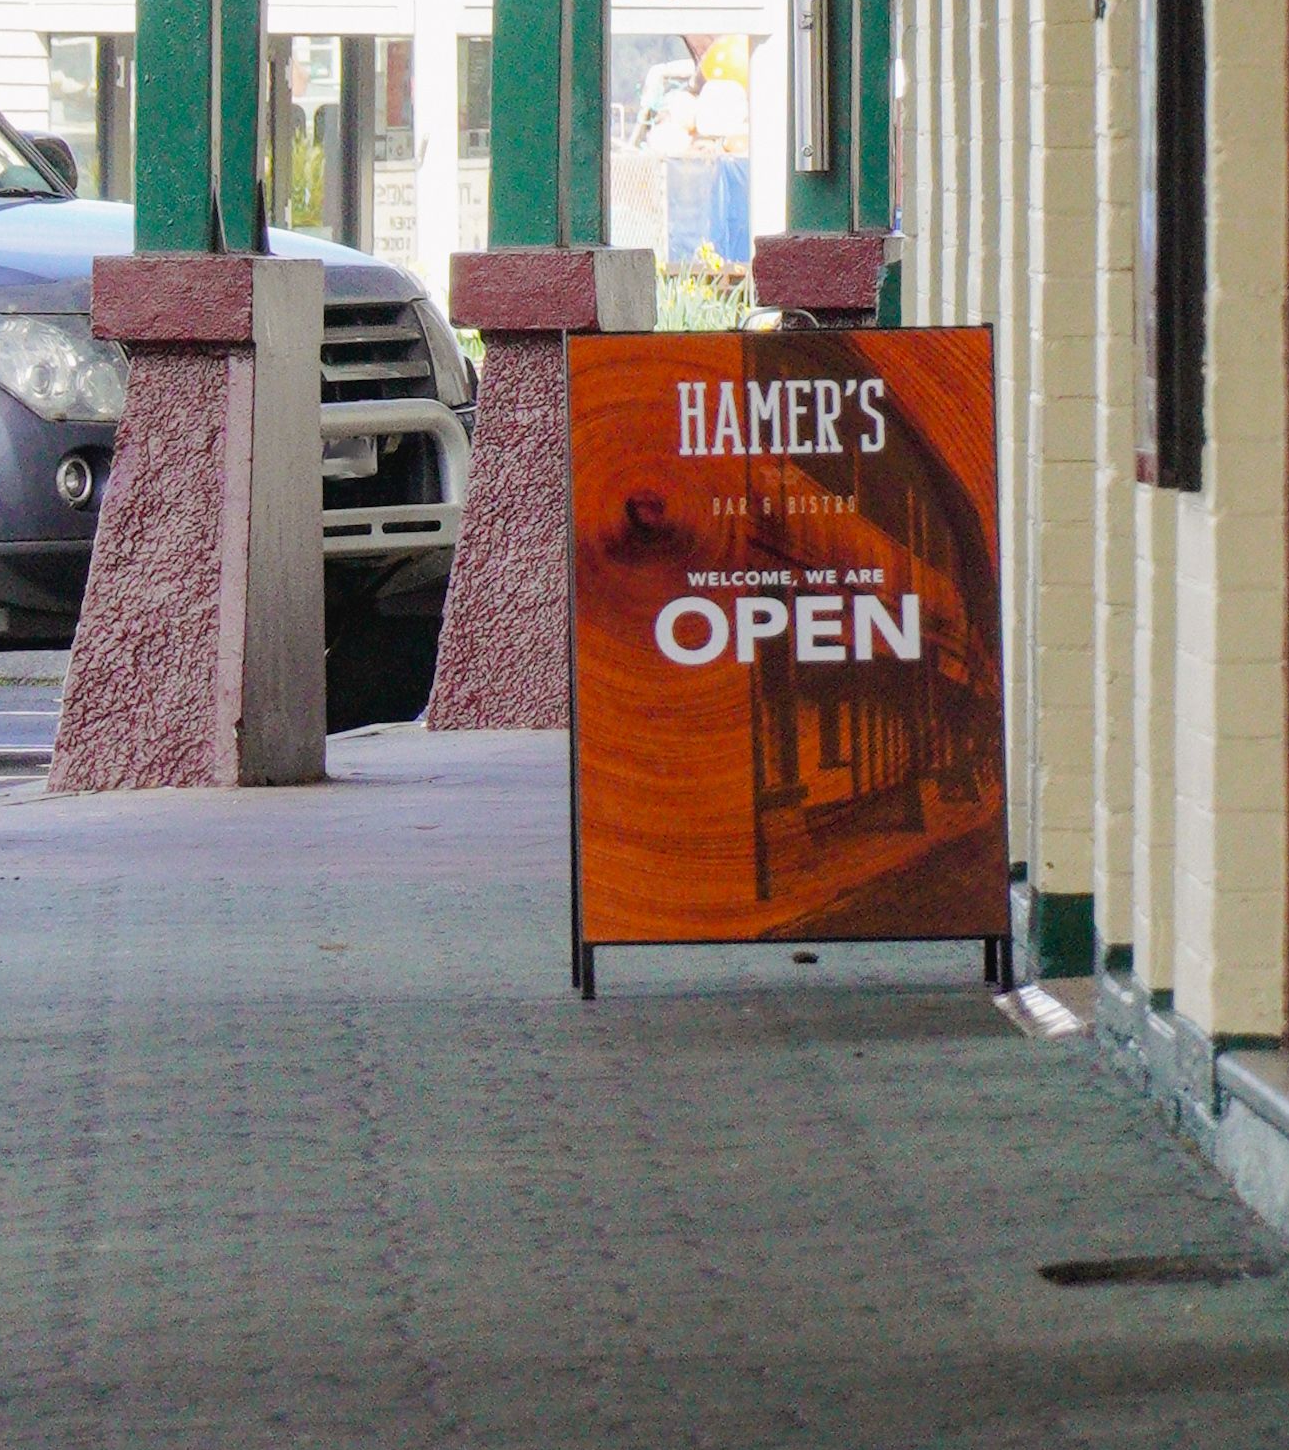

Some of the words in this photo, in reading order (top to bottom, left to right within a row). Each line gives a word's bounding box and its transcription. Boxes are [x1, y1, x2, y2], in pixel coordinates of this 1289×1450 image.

[677, 378, 886, 456] HAMER'S
[712, 496, 748, 516] BAR
[787, 494, 858, 515] BISTRO
[687, 570, 798, 587] WELCOME,
[805, 569, 837, 584] WE
[844, 568, 885, 584] ARE
[654, 593, 922, 666] OPEN
